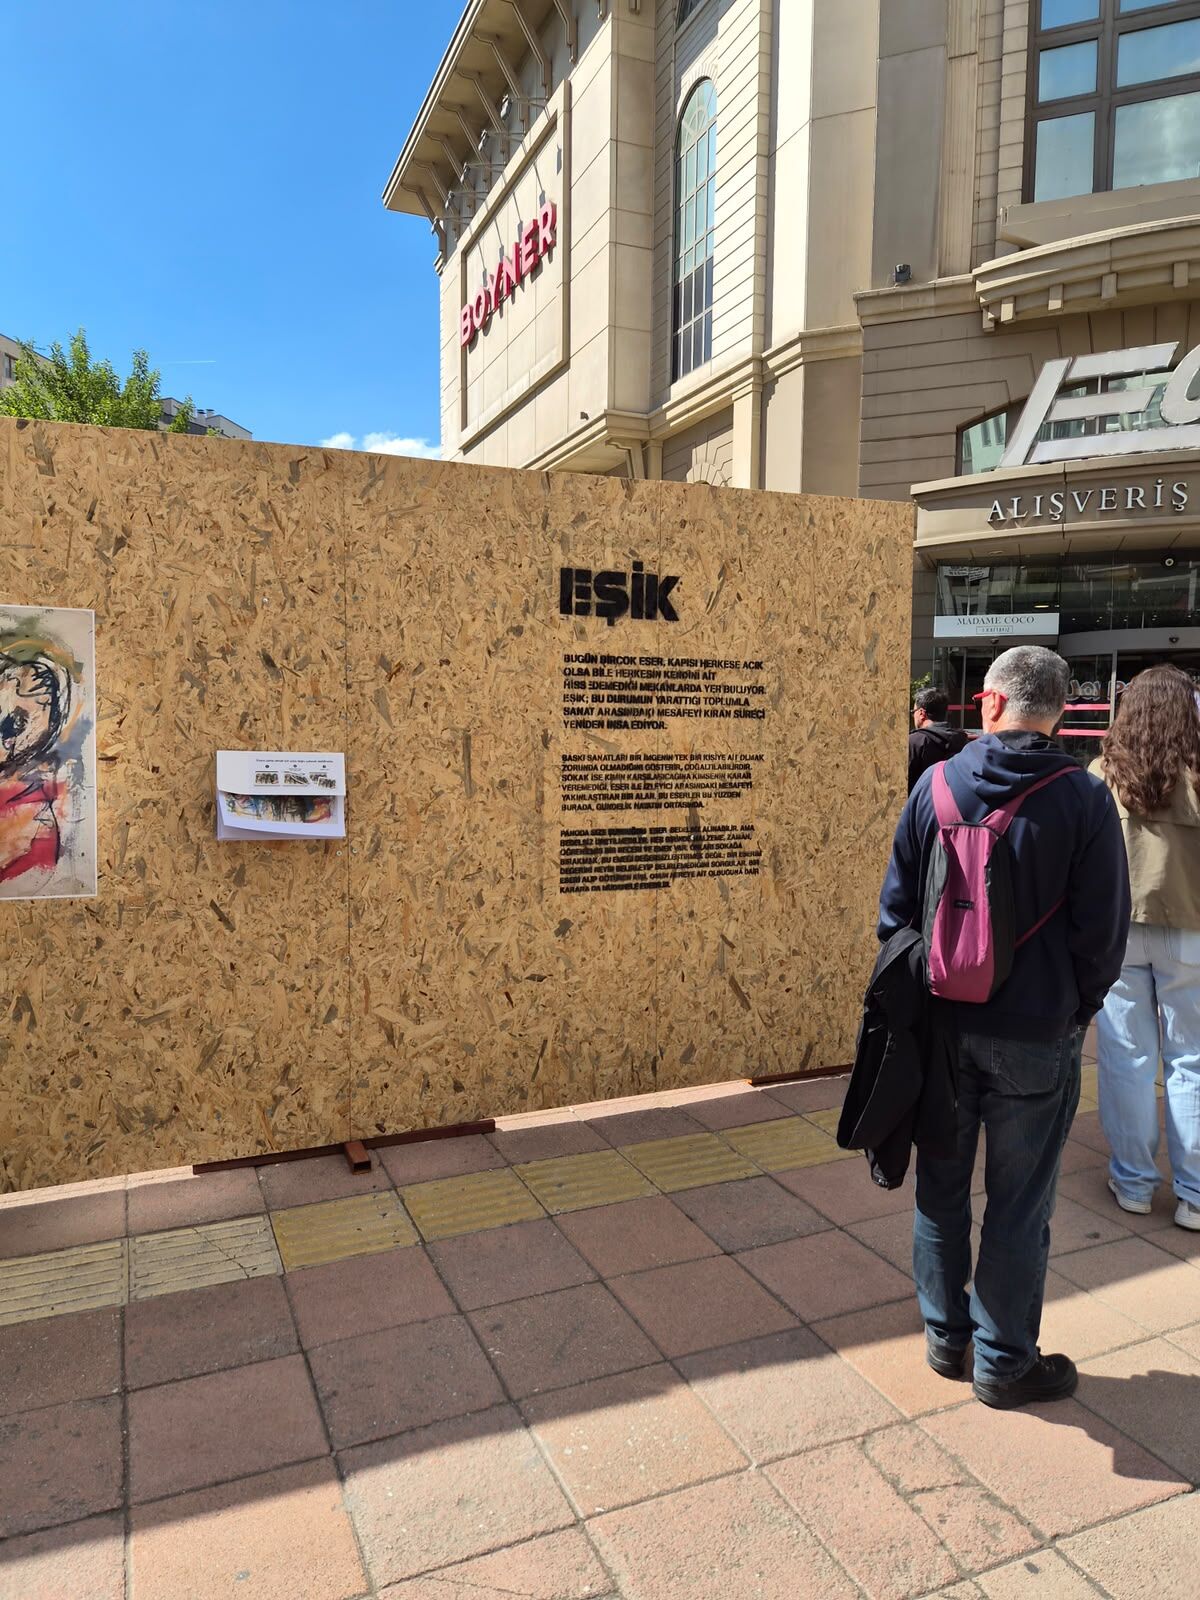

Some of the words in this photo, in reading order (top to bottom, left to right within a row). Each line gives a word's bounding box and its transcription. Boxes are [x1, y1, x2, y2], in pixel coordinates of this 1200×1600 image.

[461, 200, 557, 347] BOYNER
[986, 478, 1189, 522] ALIŞVERİŞ
[560, 561, 680, 627] EŞİK
[956, 616, 1002, 626] MADAME
[1003, 615, 1035, 625] COCO
[699, 658, 740, 669] HERKESE
[563, 667, 590, 677] OLSA
[702, 669, 716, 680] AİT
[704, 683, 721, 693] YER
[591, 694, 605, 704] BU
[606, 694, 653, 705] DURUMUN
[703, 697, 750, 707] TOPLUMLA
[563, 706, 595, 716] SANAT
[703, 708, 731, 718] KIRAN
[563, 719, 604, 729] YENİDEN
[562, 773, 589, 782] SOKAK
